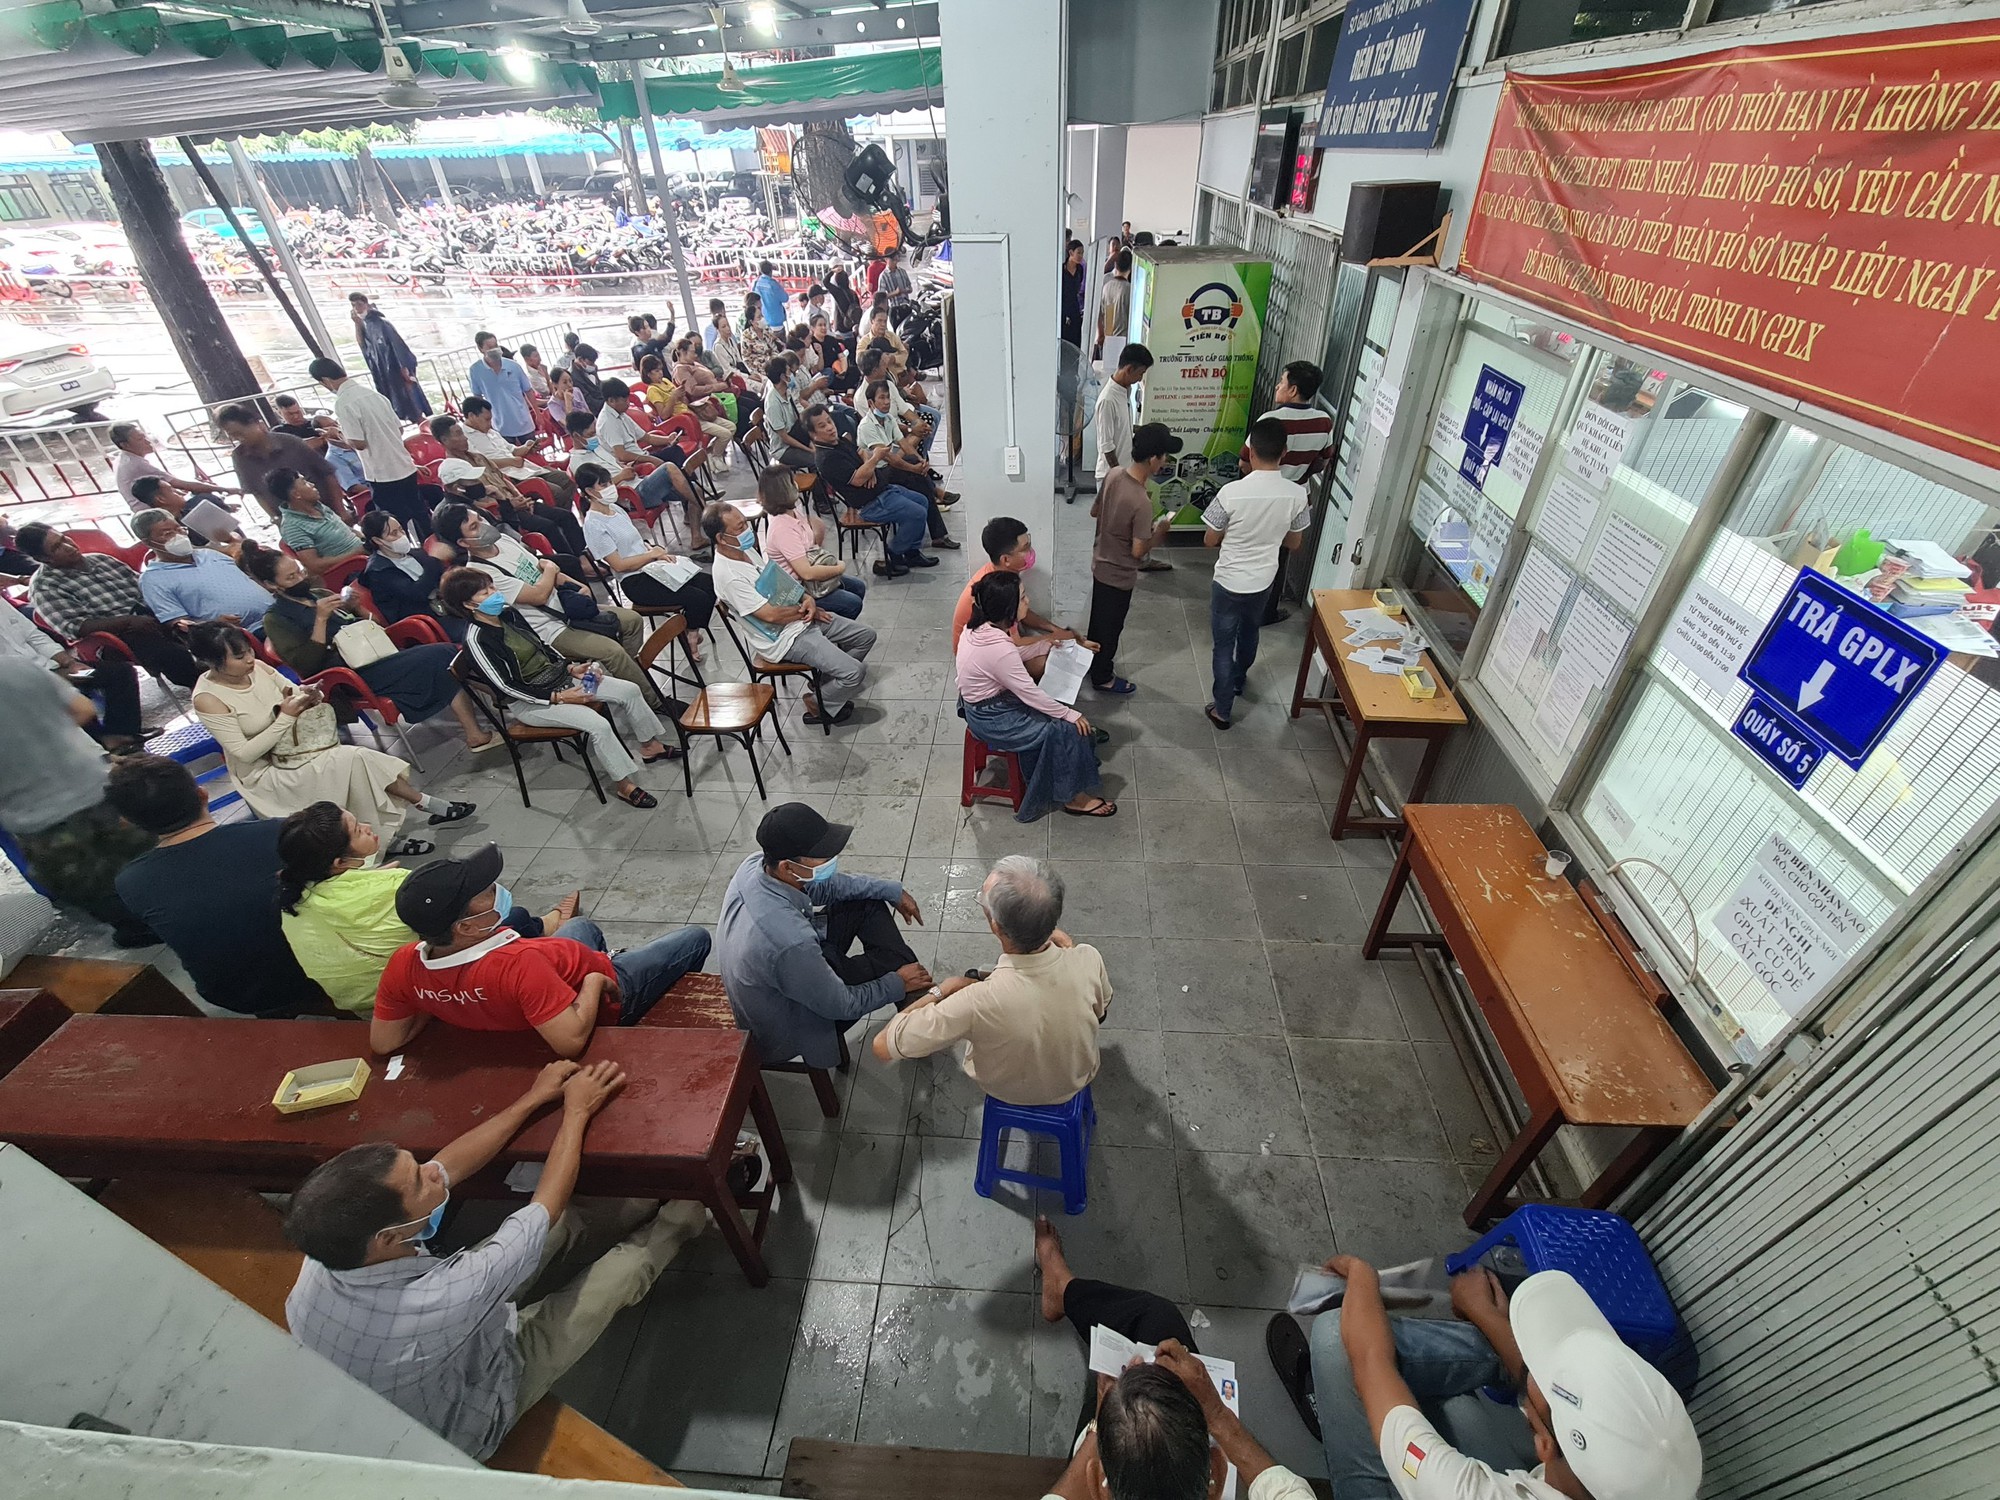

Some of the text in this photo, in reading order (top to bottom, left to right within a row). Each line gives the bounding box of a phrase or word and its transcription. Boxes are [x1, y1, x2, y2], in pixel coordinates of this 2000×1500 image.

[1370, 26, 1394, 77] TIẾP
[1389, 22, 1426, 79] NHẬN
[1352, 88, 1377, 134] GIẤY
[1371, 87, 1402, 134] PHÉP
[1395, 83, 1421, 133] LÁI
[1413, 91, 1438, 132] XE
[1612, 90, 1653, 131] TÁCH
[1649, 101, 1662, 131] 2
[1660, 96, 1704, 132] GPLX
[1699, 82, 1739, 135] (CÓ
[1731, 79, 1787, 131] THỜI
[1777, 89, 1838, 141] HẠN
[1832, 73, 1875, 132] VÀ
[1864, 69, 1983, 131] KHÔNG
[1562, 156, 1599, 186] GPLX
[1598, 158, 1621, 188] PET
[1699, 162, 1740, 199] KHI
[1731, 153, 1780, 212] NỘP
[1771, 144, 1822, 206] HỒ
[1805, 161, 1853, 219] SƠ,
[1848, 157, 1912, 216] YÊU
[1904, 145, 1983, 221] CẦU
[1494, 183, 1515, 219] CẤP
[1510, 185, 1532, 222] SỐ
[1523, 199, 1553, 229] GPLX
[1569, 208, 1591, 239] CHO
[1586, 204, 1617, 245] CÁN
[1614, 209, 1640, 256] BỘ
[1633, 206, 1673, 255] TIẾP
[1666, 218, 1716, 270] NHẬN
[1711, 212, 1754, 269] HỒ
[1740, 231, 1782, 275] SƠ
[1767, 232, 1839, 294] NHẬP
[1830, 240, 1906, 306] LIỆU
[1893, 259, 1996, 315] NGAY
[1201, 308, 1222, 321] TB
[1535, 249, 1575, 286] KHÔNG
[1607, 273, 1654, 313] TRONG
[1649, 280, 1691, 324] QUÁ
[1681, 286, 1742, 337] TRÌNH
[1733, 306, 1767, 345] IN
[1760, 313, 1825, 362] GPLX
[1180, 364, 1227, 380] TIẾN BỘ
[1205, 353, 1217, 362] CẤP
[1234, 354, 1253, 362] THÔNG
[1576, 420, 1623, 452] QUÝ KHÁCH LIÊN
[1584, 410, 1625, 438] ĐƠN ĐỔI GPLX
[1578, 464, 1592, 478] SINH
[1589, 442, 1601, 455] KHU
[1602, 451, 1607, 459] A
[1682, 616, 1736, 661] SÁNG 7:30 ĐẾN 11:30
[1695, 592, 1750, 637] THỜI GIAN LÀM VIỆC
[1696, 611, 1710, 623] THỨ
[1712, 623, 1726, 637] ĐẾN
[1725, 632, 1739, 646] THỨ
[1676, 627, 1729, 673] CHIỀU 13:00 ĐẾN 17:00
[1787, 592, 1921, 694] TRẢ GPLX
[1741, 707, 1812, 774] QUẦY SỐ 5
[1771, 836, 1865, 933] NỘP BIÊN NHẬN VÀO
[1787, 871, 1810, 893] CHỜ
[1807, 892, 1827, 912] GỌI
[1826, 909, 1847, 933] TÊN
[1734, 911, 1766, 949] GPLX
[1764, 947, 1784, 969] CŨ
[1740, 896, 1815, 981] XUẤT TRÌNH
[1757, 874, 1772, 889] KHI
[1770, 887, 1781, 899] ĐI
[1800, 920, 1821, 943] GPLX
[1820, 942, 1838, 961] MỚI
[1780, 916, 1812, 955] NGHỊ
[1754, 961, 1783, 994] GÓC
